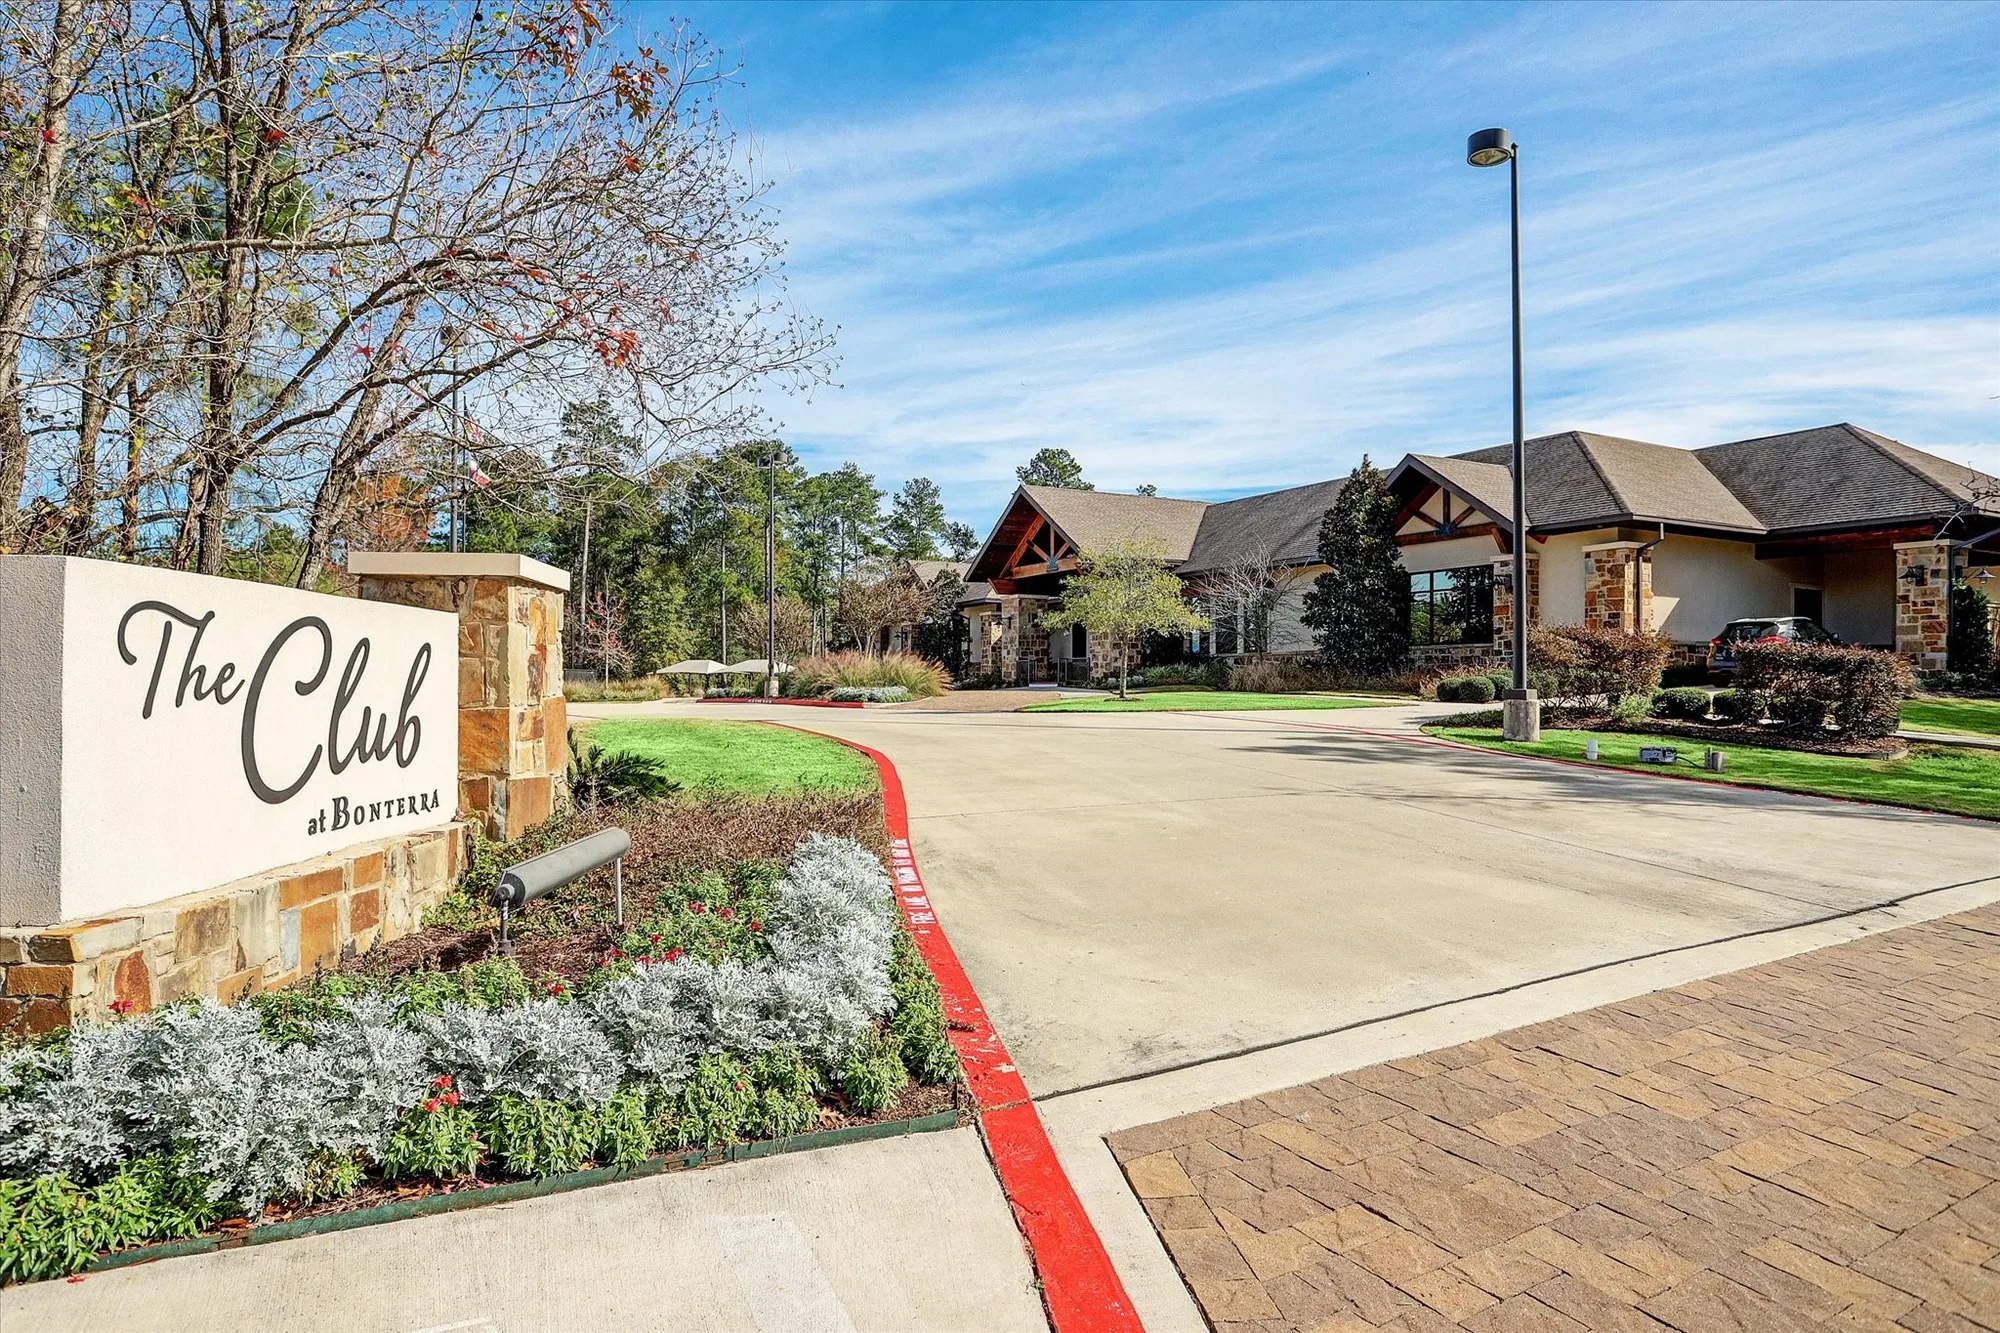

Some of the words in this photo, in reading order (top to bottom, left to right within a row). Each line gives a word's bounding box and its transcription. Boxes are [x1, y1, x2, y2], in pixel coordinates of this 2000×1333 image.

[117, 600, 246, 719] The
[241, 616, 432, 805] Club
[308, 809, 326, 836] at
